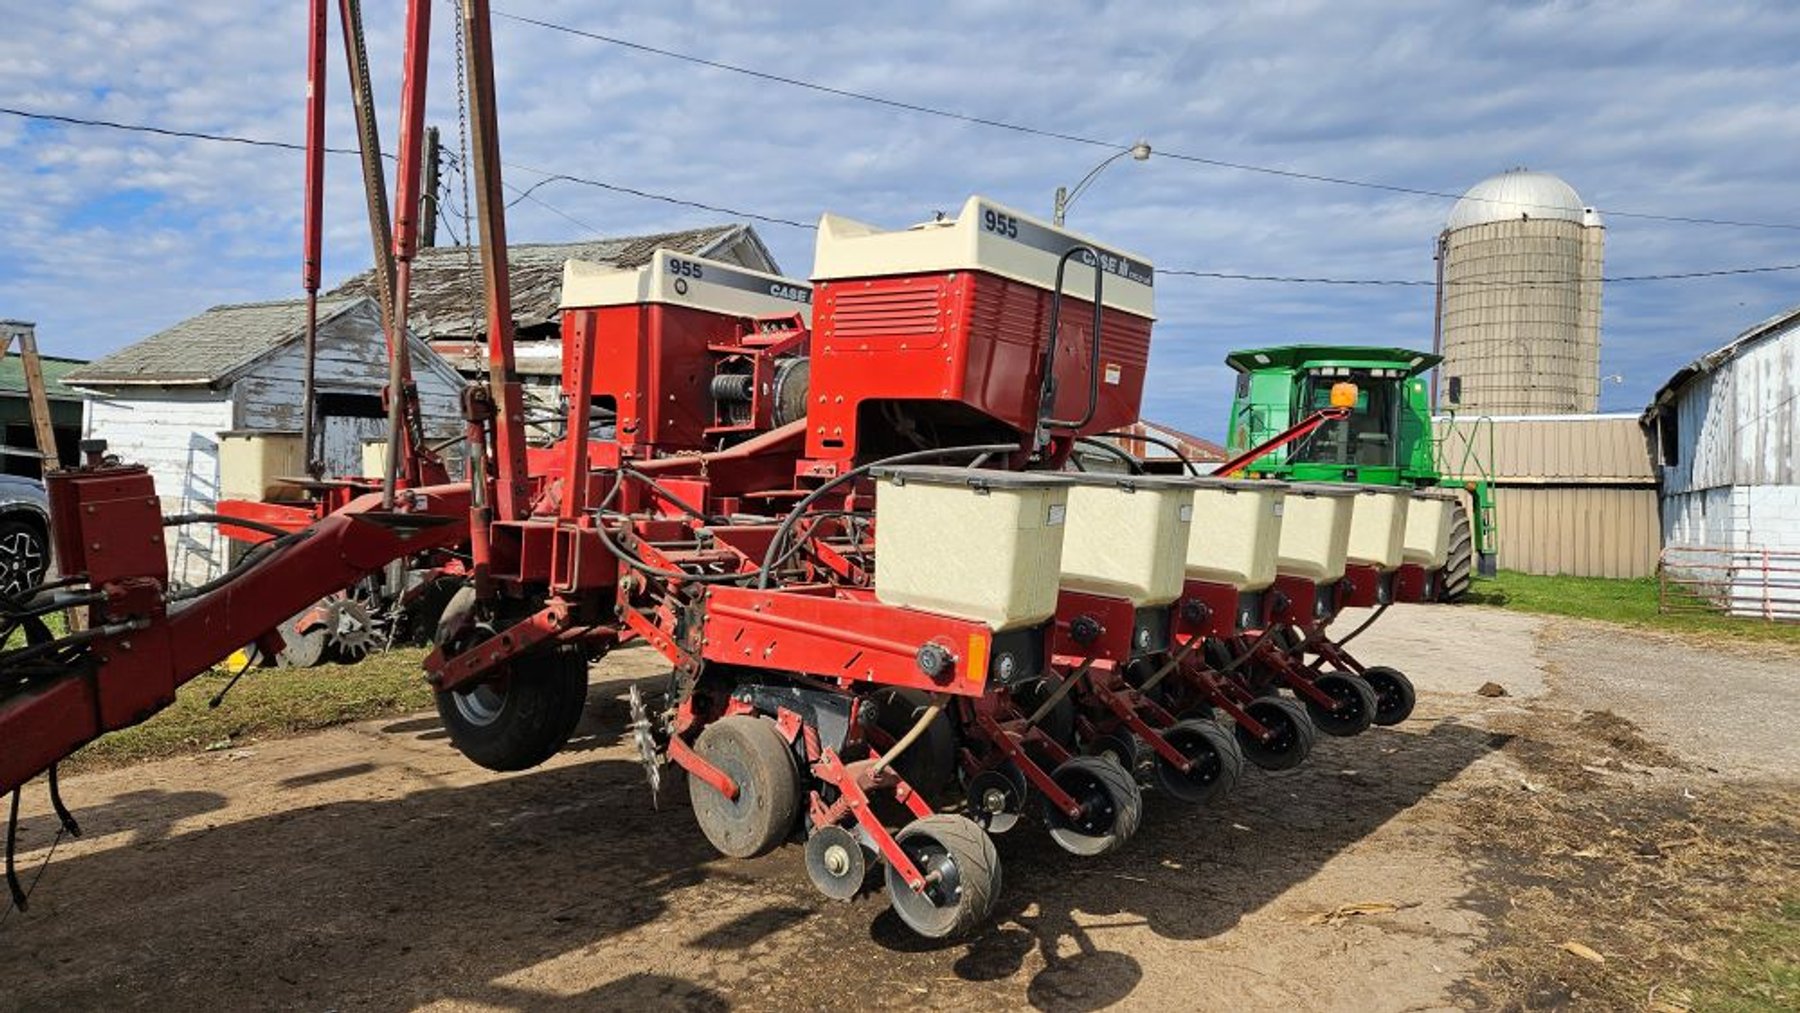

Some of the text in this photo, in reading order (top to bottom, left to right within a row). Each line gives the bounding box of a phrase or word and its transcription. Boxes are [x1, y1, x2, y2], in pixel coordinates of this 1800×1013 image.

[985, 209, 1018, 239] 955
[669, 258, 703, 279] 955
[770, 284, 807, 302] CASE
